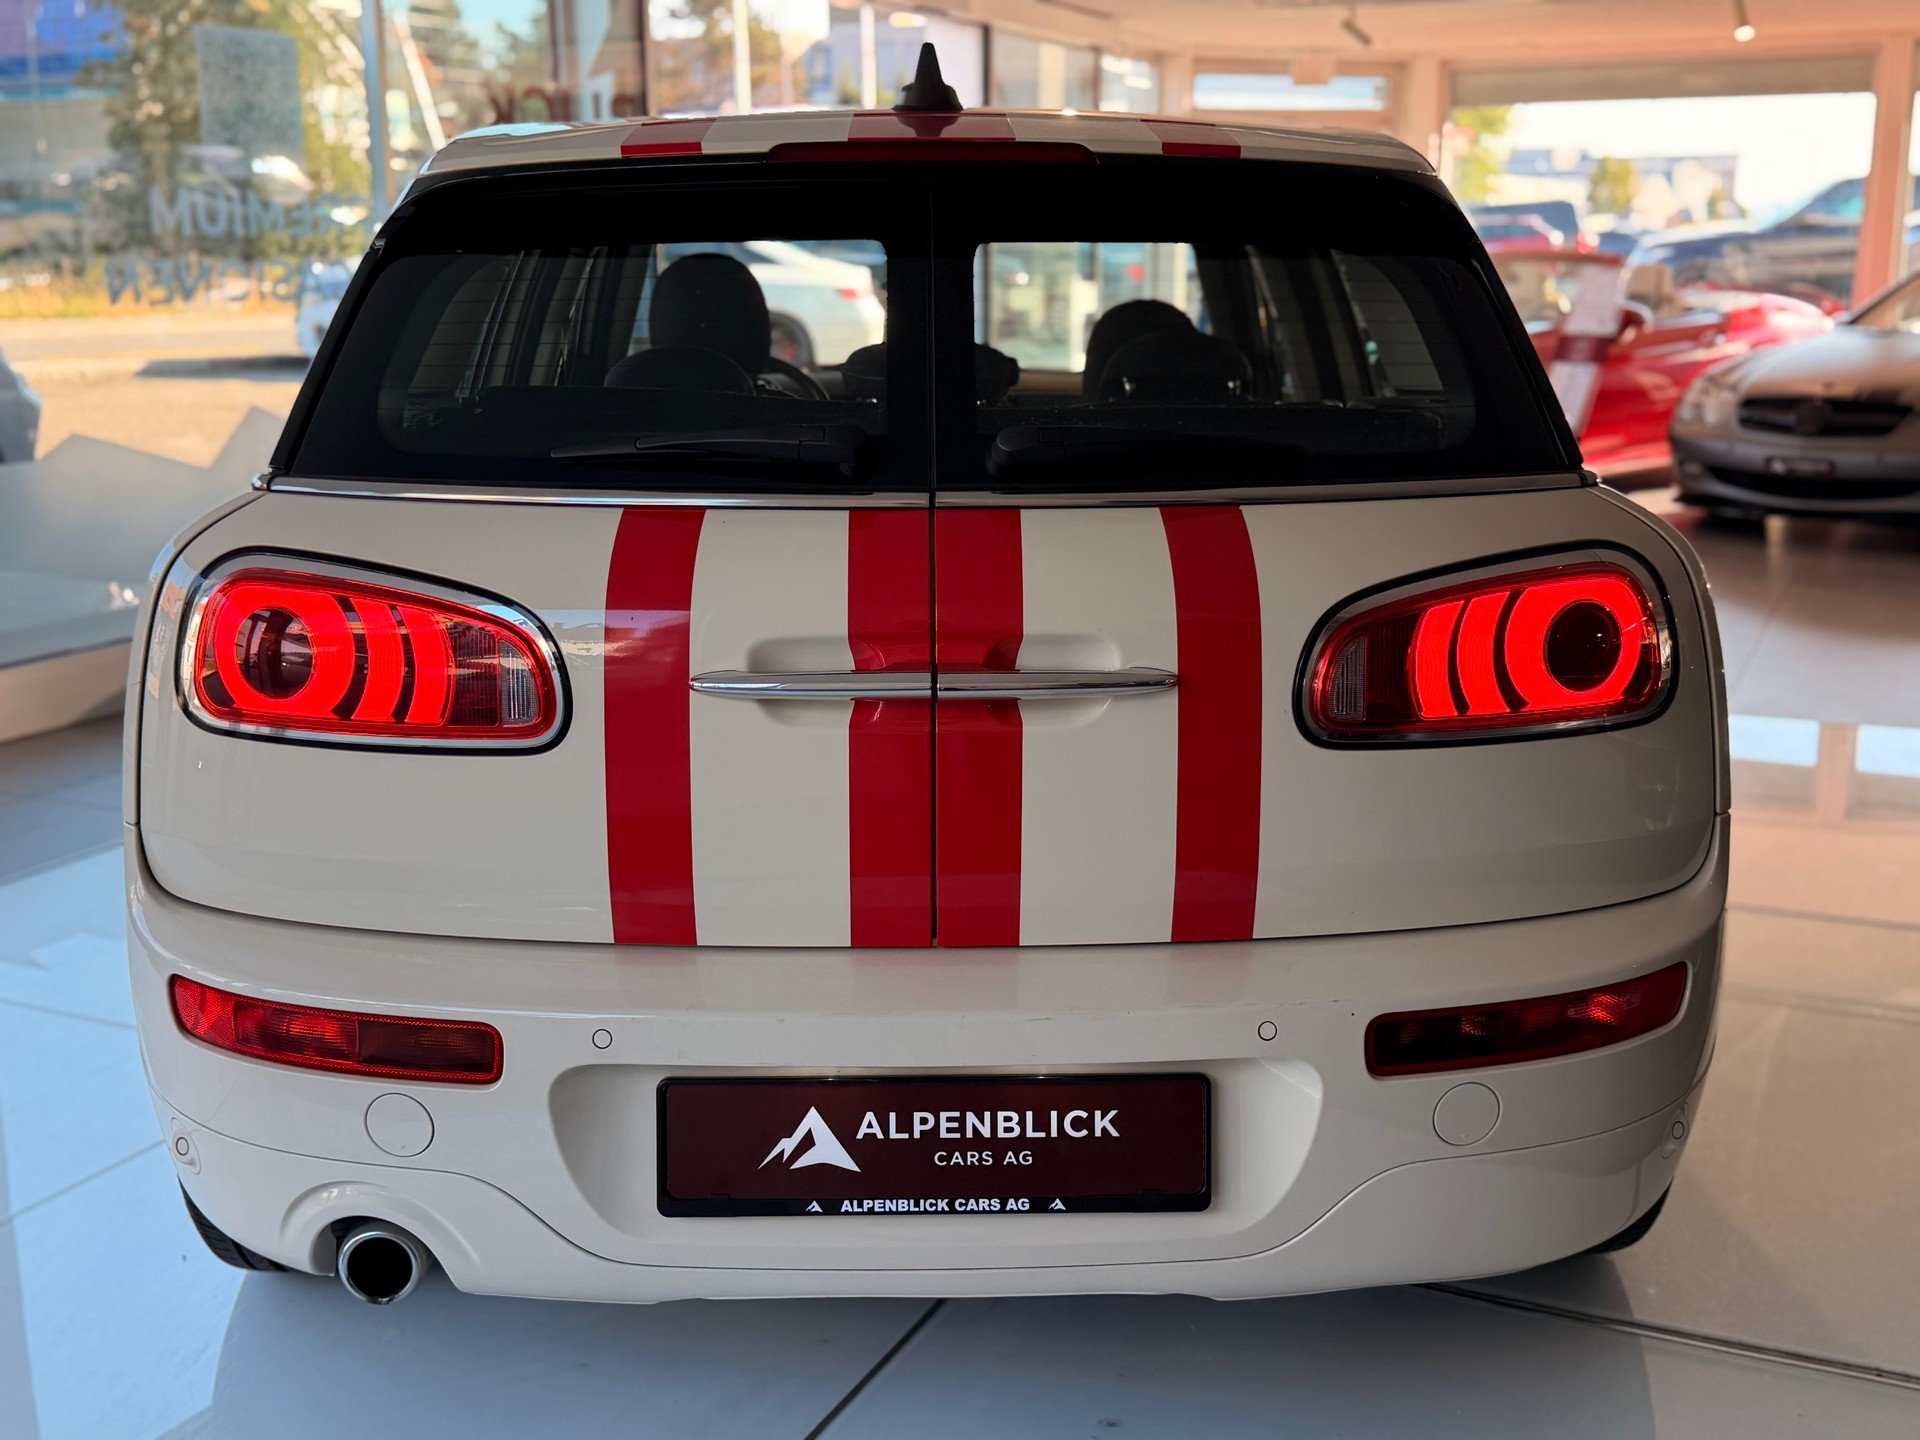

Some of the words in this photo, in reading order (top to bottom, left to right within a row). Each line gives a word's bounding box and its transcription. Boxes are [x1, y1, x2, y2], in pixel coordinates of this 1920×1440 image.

[855, 1110, 1120, 1139] ALPENBLICK
[934, 1151, 993, 1166] CARS
[1003, 1151, 1033, 1165] AG
[840, 1199, 950, 1212] ALPENBLICK
[954, 1199, 1001, 1211] CARS
[1005, 1199, 1030, 1211] AG
